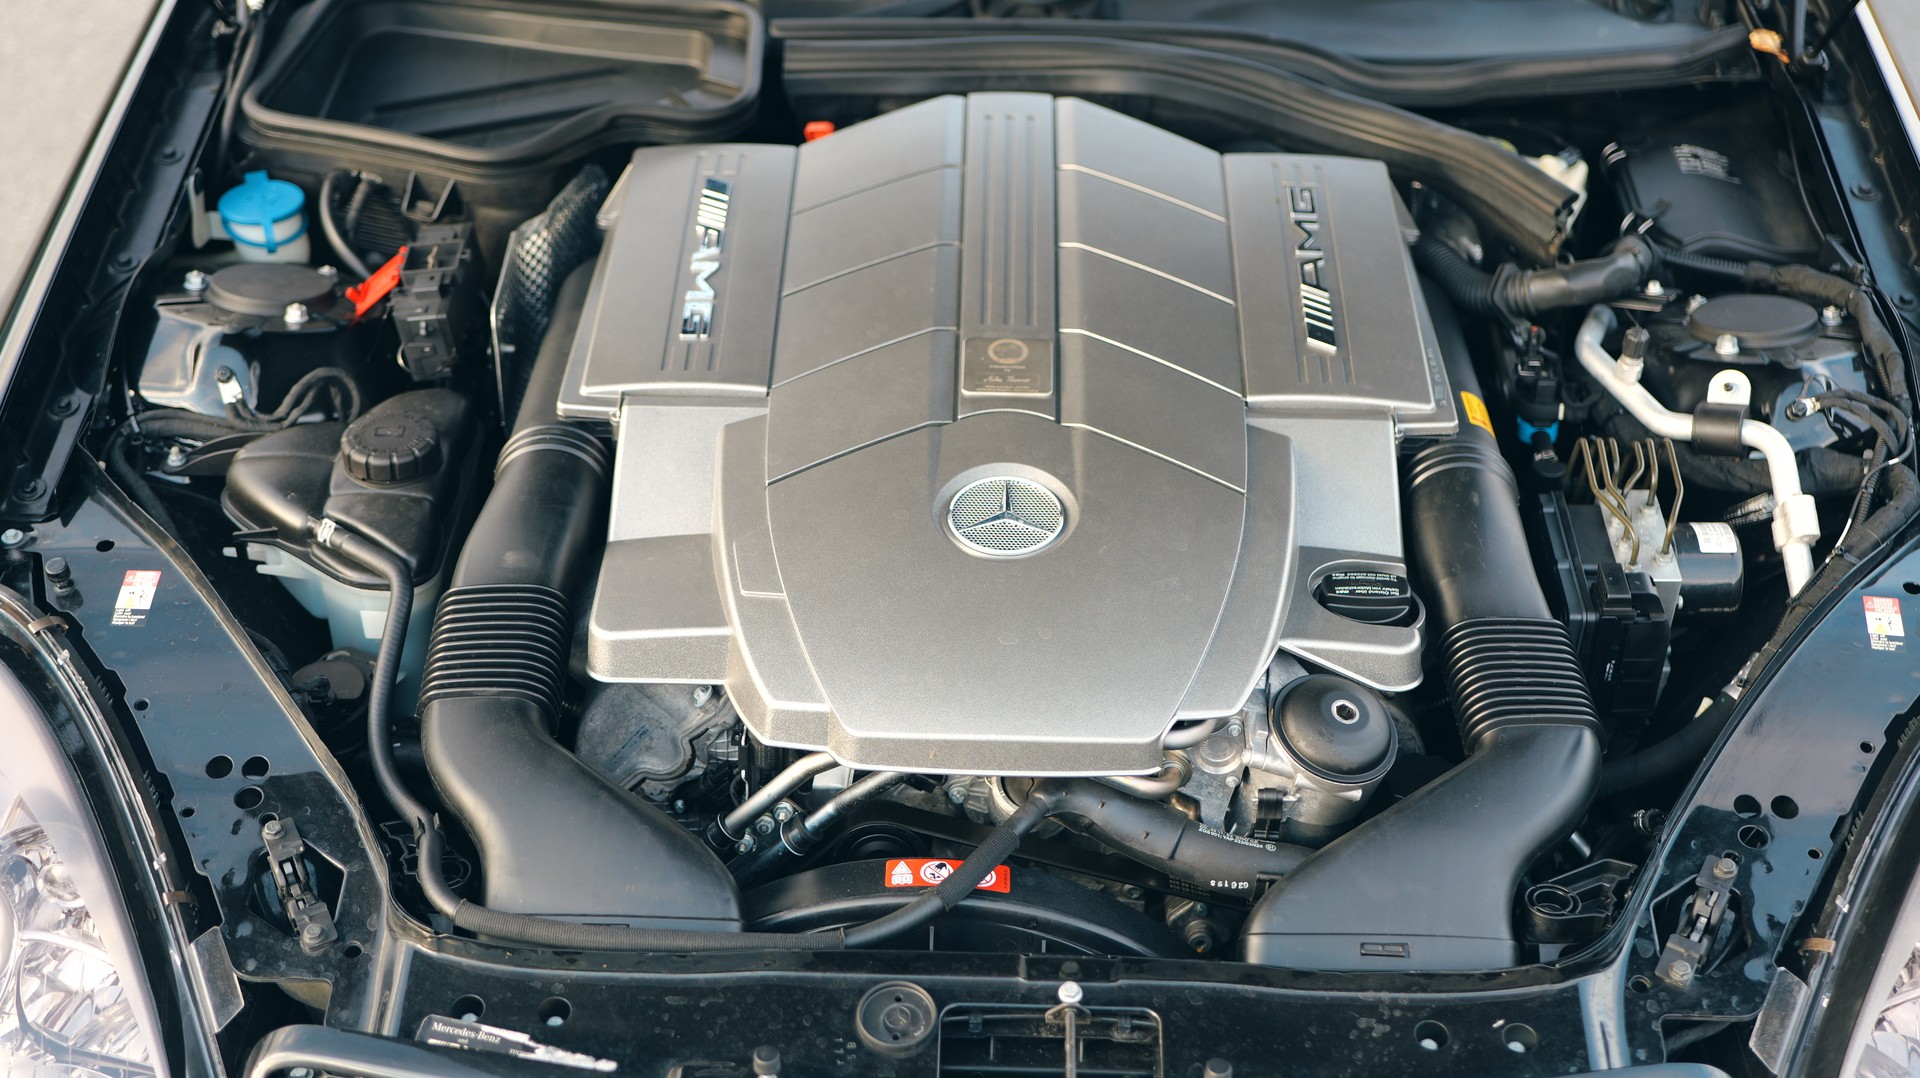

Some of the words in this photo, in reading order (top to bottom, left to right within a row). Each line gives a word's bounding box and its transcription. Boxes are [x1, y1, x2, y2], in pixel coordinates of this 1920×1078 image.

[680, 225, 726, 342] AMG
[1283, 182, 1326, 293] AMG
[431, 1021, 501, 1044] Mercedes-Benz
